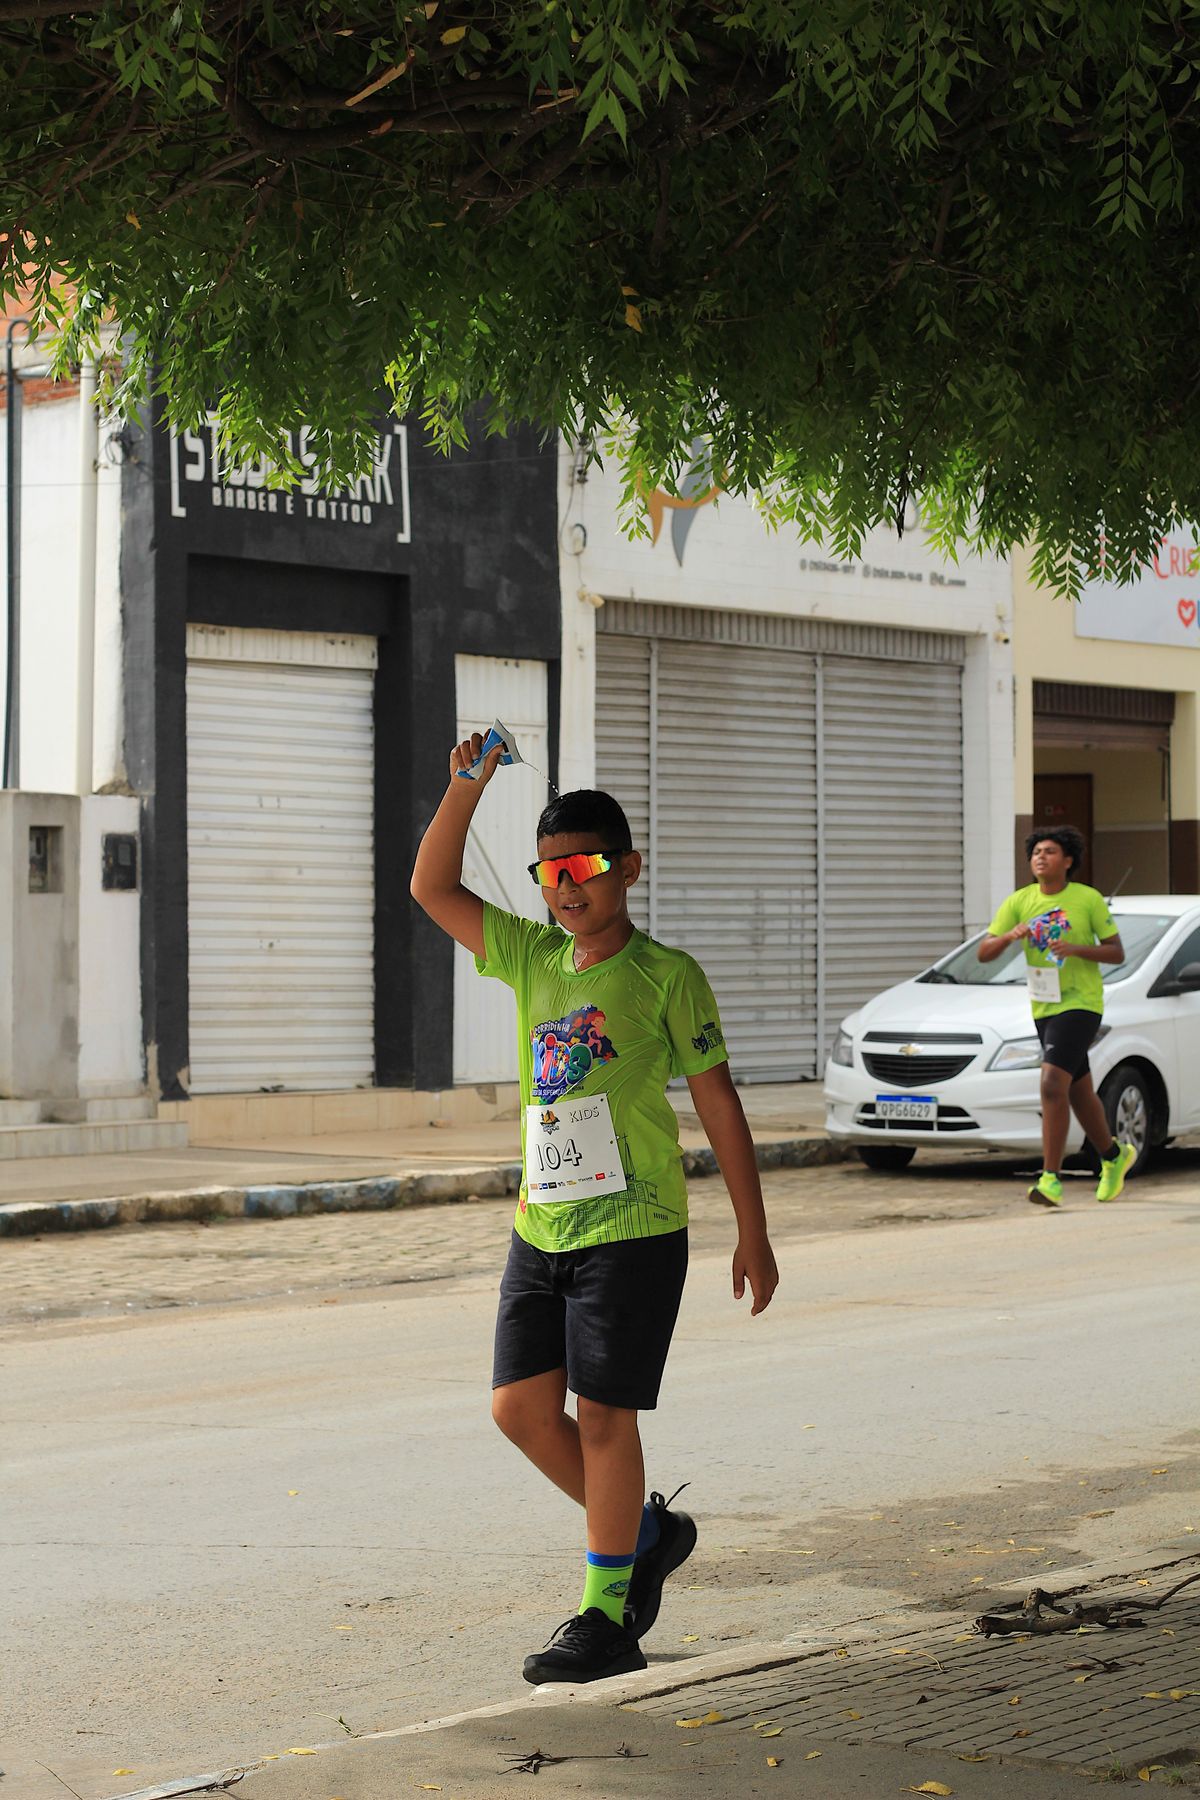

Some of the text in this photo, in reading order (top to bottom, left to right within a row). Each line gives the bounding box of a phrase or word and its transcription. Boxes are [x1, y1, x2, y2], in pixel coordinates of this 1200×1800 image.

[211, 486, 372, 525] BARBER E TATTOO
[569, 1106, 600, 1123] KIDS
[535, 1138, 583, 1172] 104
